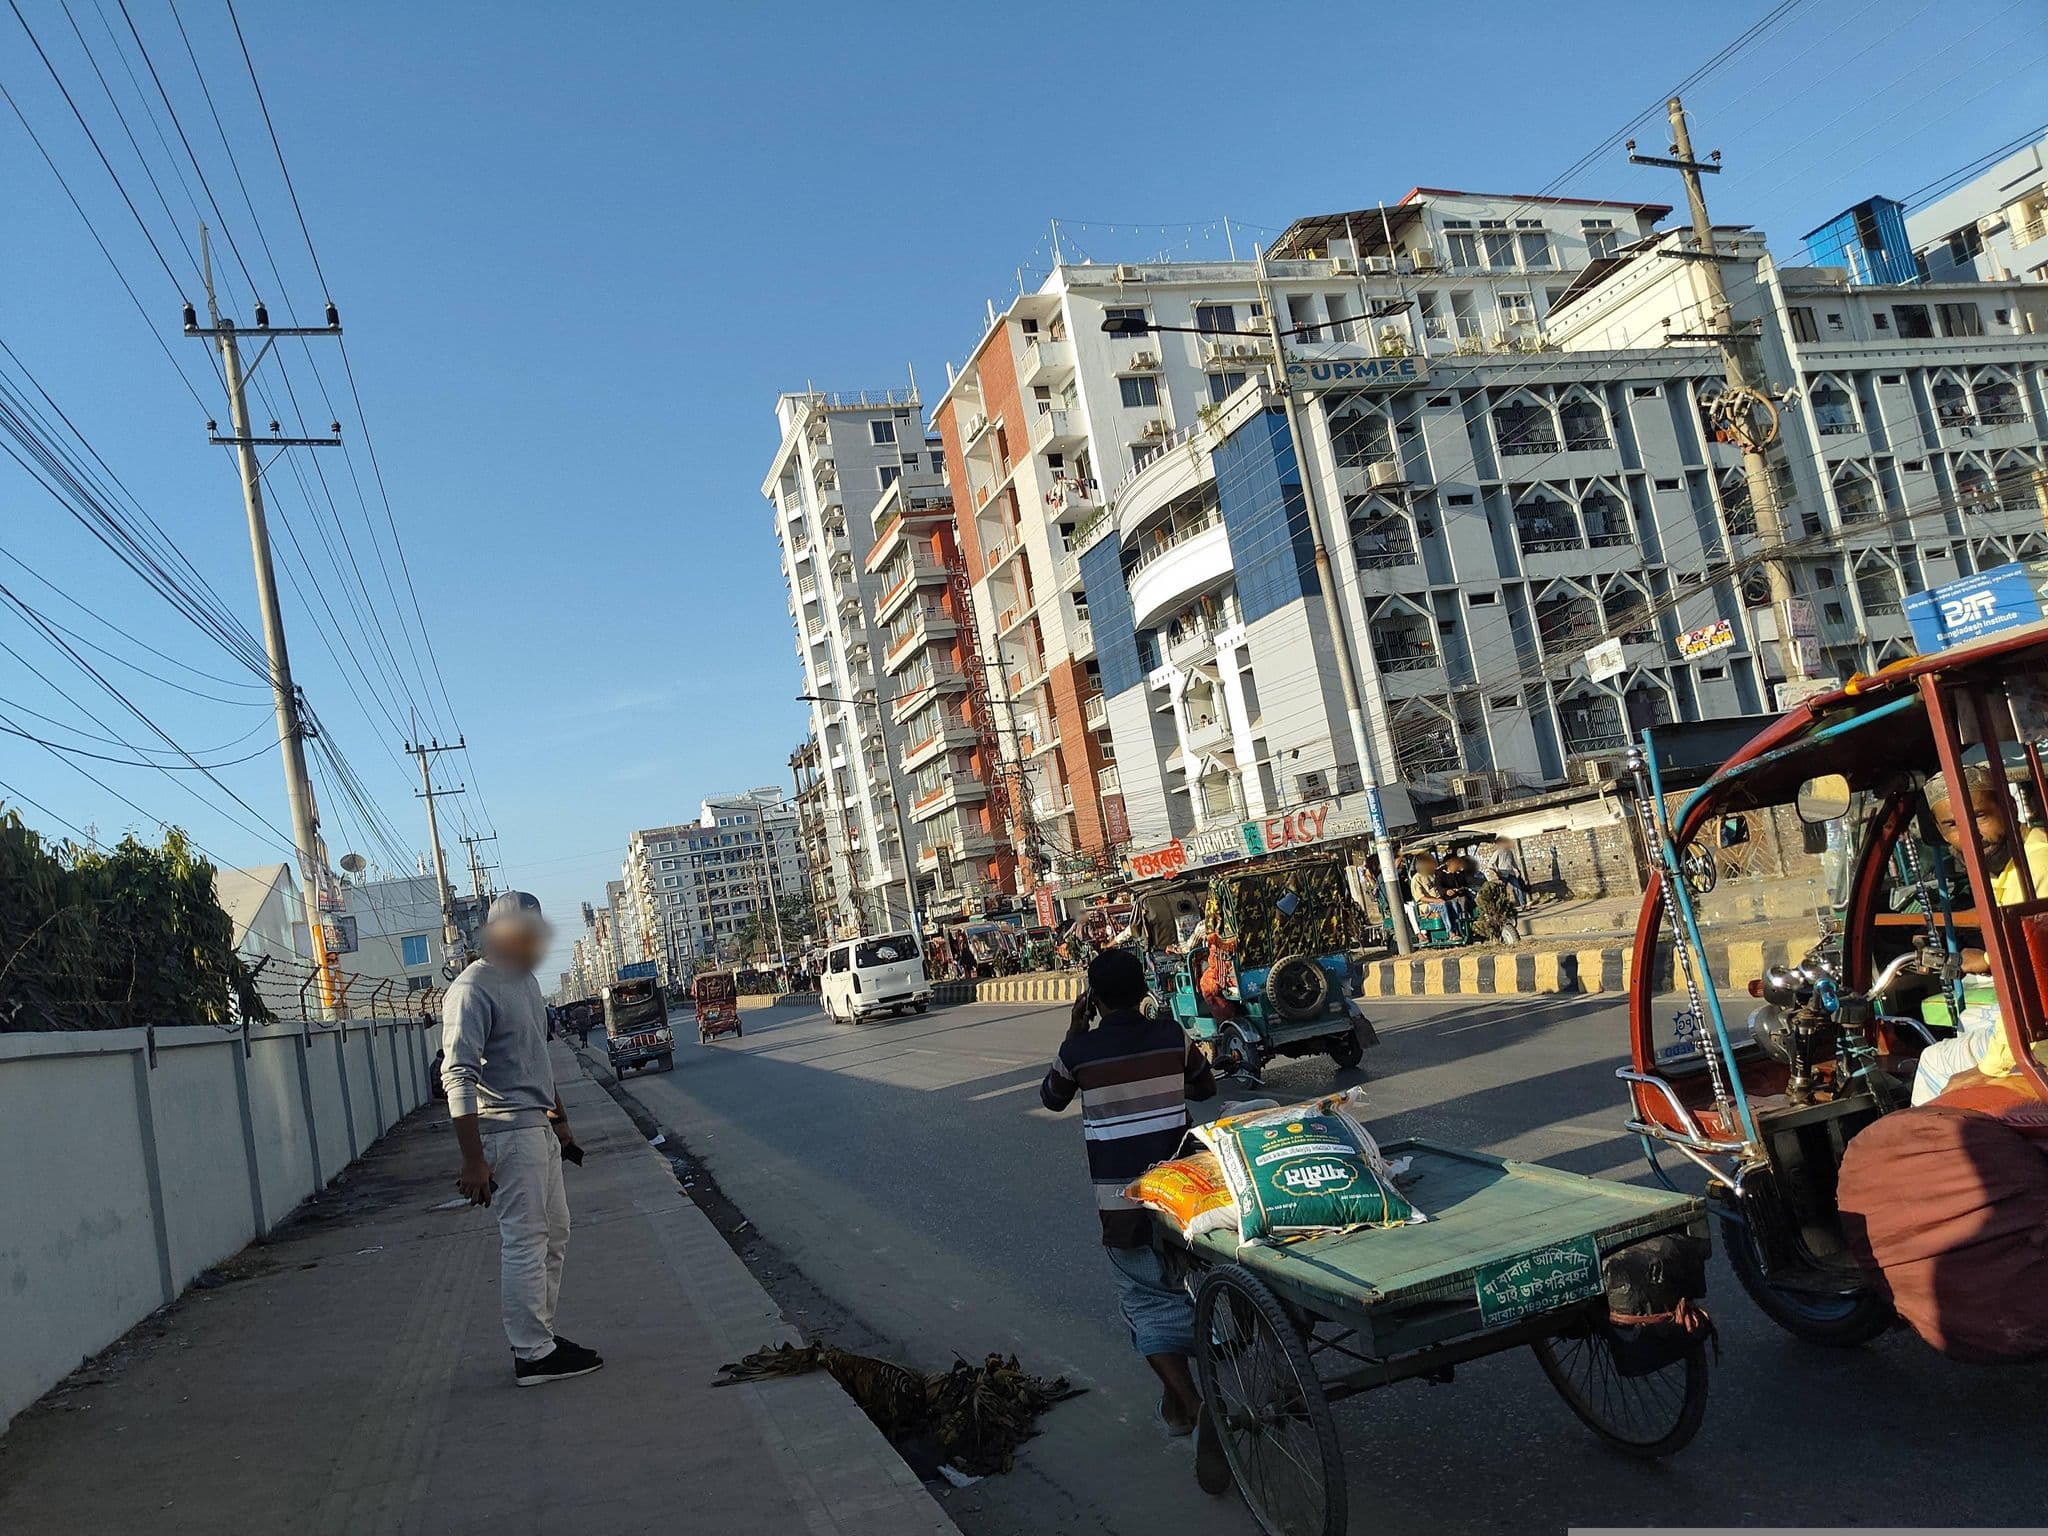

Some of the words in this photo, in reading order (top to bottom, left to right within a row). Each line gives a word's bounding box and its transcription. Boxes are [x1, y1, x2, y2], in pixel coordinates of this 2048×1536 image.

[1312, 359, 1417, 380] URMEE
[951, 557, 979, 646] HOTEL
[1983, 611, 2017, 627] Institute
[1686, 641, 1707, 654] SPA
[1711, 632, 1731, 645] SPA
[1265, 803, 1329, 849] EASY
[1195, 828, 1240, 855] URMEE
[1496, 1284, 1519, 1304] ভাই
[1520, 1277, 1544, 1298] ভাই
[1545, 1267, 1590, 1291] পরিবহন
